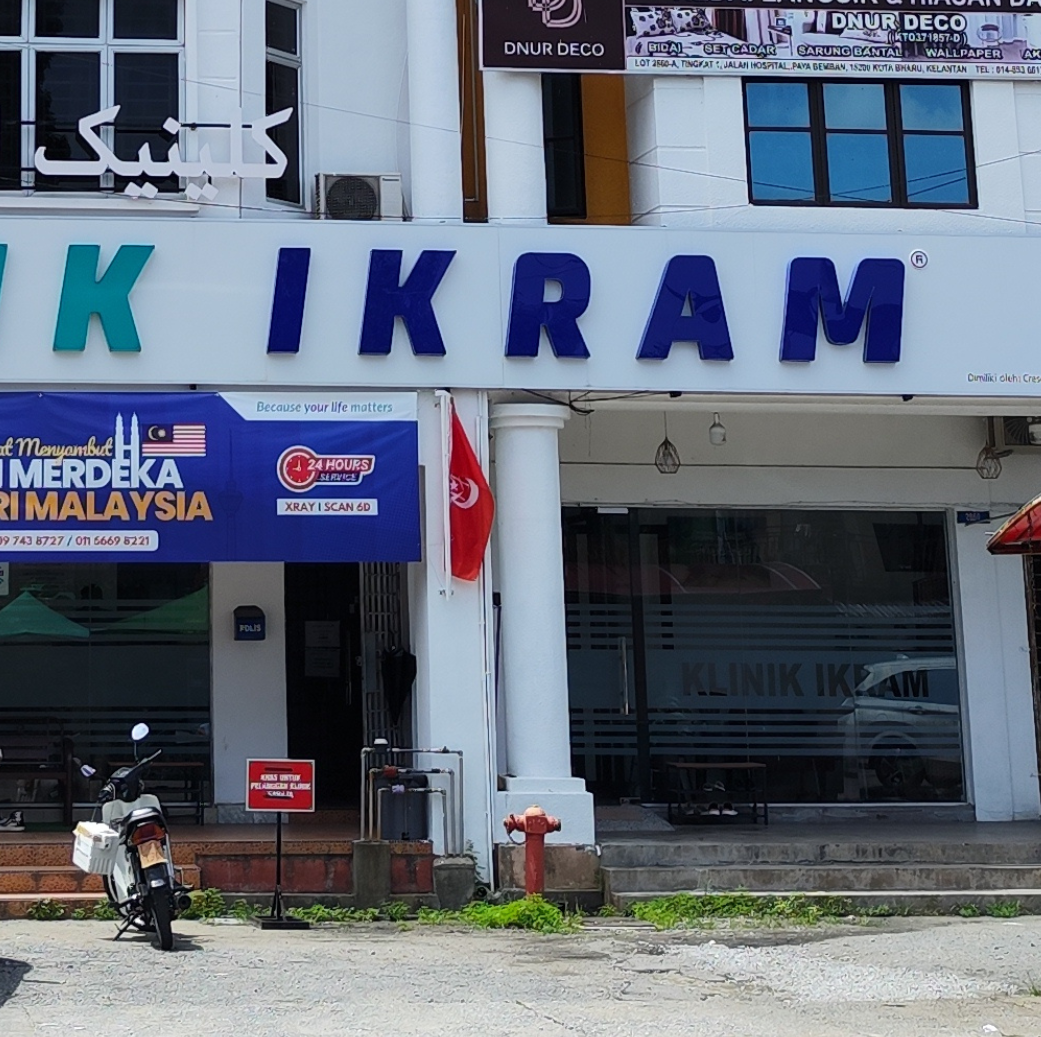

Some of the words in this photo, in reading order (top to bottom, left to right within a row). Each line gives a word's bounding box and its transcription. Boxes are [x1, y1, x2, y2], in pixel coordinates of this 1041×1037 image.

[831, 14, 899, 31] DNUR
[904, 14, 966, 32] DECO
[504, 41, 553, 55] DNUR
[557, 42, 605, 56] DECO
[648, 43, 682, 53] BIDAI
[704, 44, 728, 54] SET
[731, 44, 776, 55] CADAR
[798, 46, 850, 56] SARUNG
[853, 46, 902, 57] BANTAL
[926, 48, 1002, 59] WALLPAPER
[266, 246, 905, 364] IKRAM
[256, 401, 302, 412] Because
[304, 402, 329, 414] your
[330, 401, 348, 413] life
[350, 402, 393, 413] matters
[16, 437, 113, 465] Menyambut
[307, 459, 323, 471] 24
[325, 459, 370, 471] HOURS
[10, 458, 184, 489] MERDEKA
[319, 473, 357, 482] SERVICE
[25, 491, 213, 521] MALAYSIA
[285, 501, 315, 512] XRAY
[324, 501, 354, 512] SCAN
[357, 501, 371, 512] 6D
[12, 535, 33, 546] 743
[682, 663, 804, 696] KLINIK
